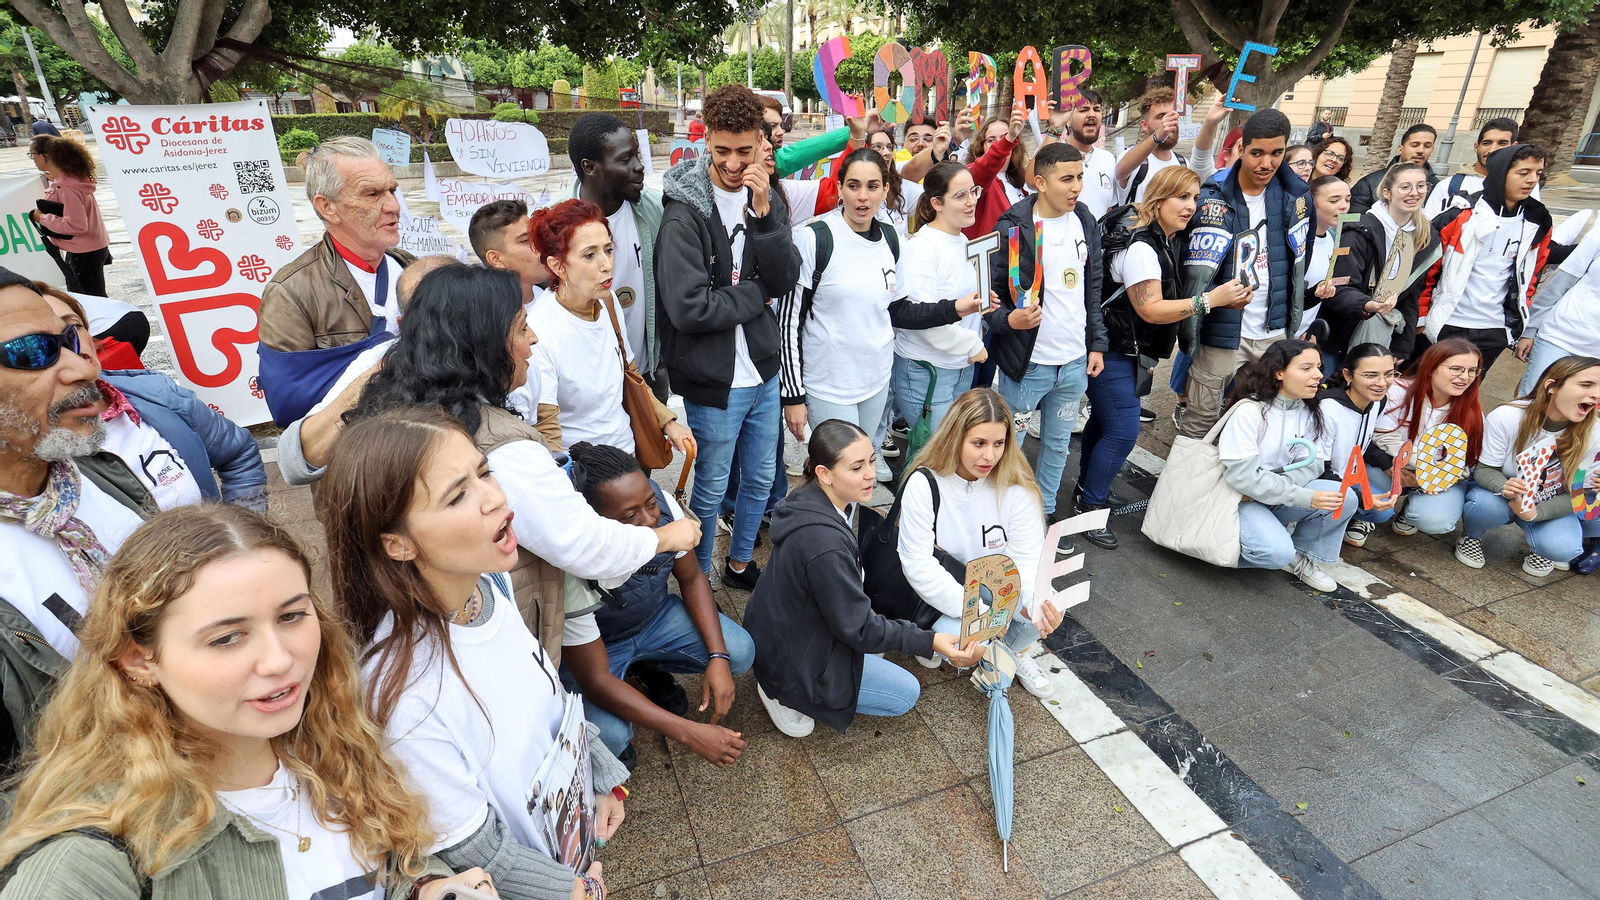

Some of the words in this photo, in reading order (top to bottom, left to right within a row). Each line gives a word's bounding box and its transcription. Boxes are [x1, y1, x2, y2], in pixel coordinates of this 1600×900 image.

[151, 115, 265, 136] Cáritas
[160, 138, 209, 148] Diocesana
[211, 136, 223, 145] de
[163, 147, 228, 158] Asidonia-Jerez
[469, 145, 496, 160] SIN
[121, 162, 218, 175] www.caritas.es/jerez
[486, 157, 547, 173] VIVIENDA
[251, 207, 277, 216] bizum
[256, 215, 276, 223] 00315
[1188, 233, 1228, 253] NOR
[1189, 250, 1220, 261] ROYAL
[161, 471, 185, 487] HOGAR
